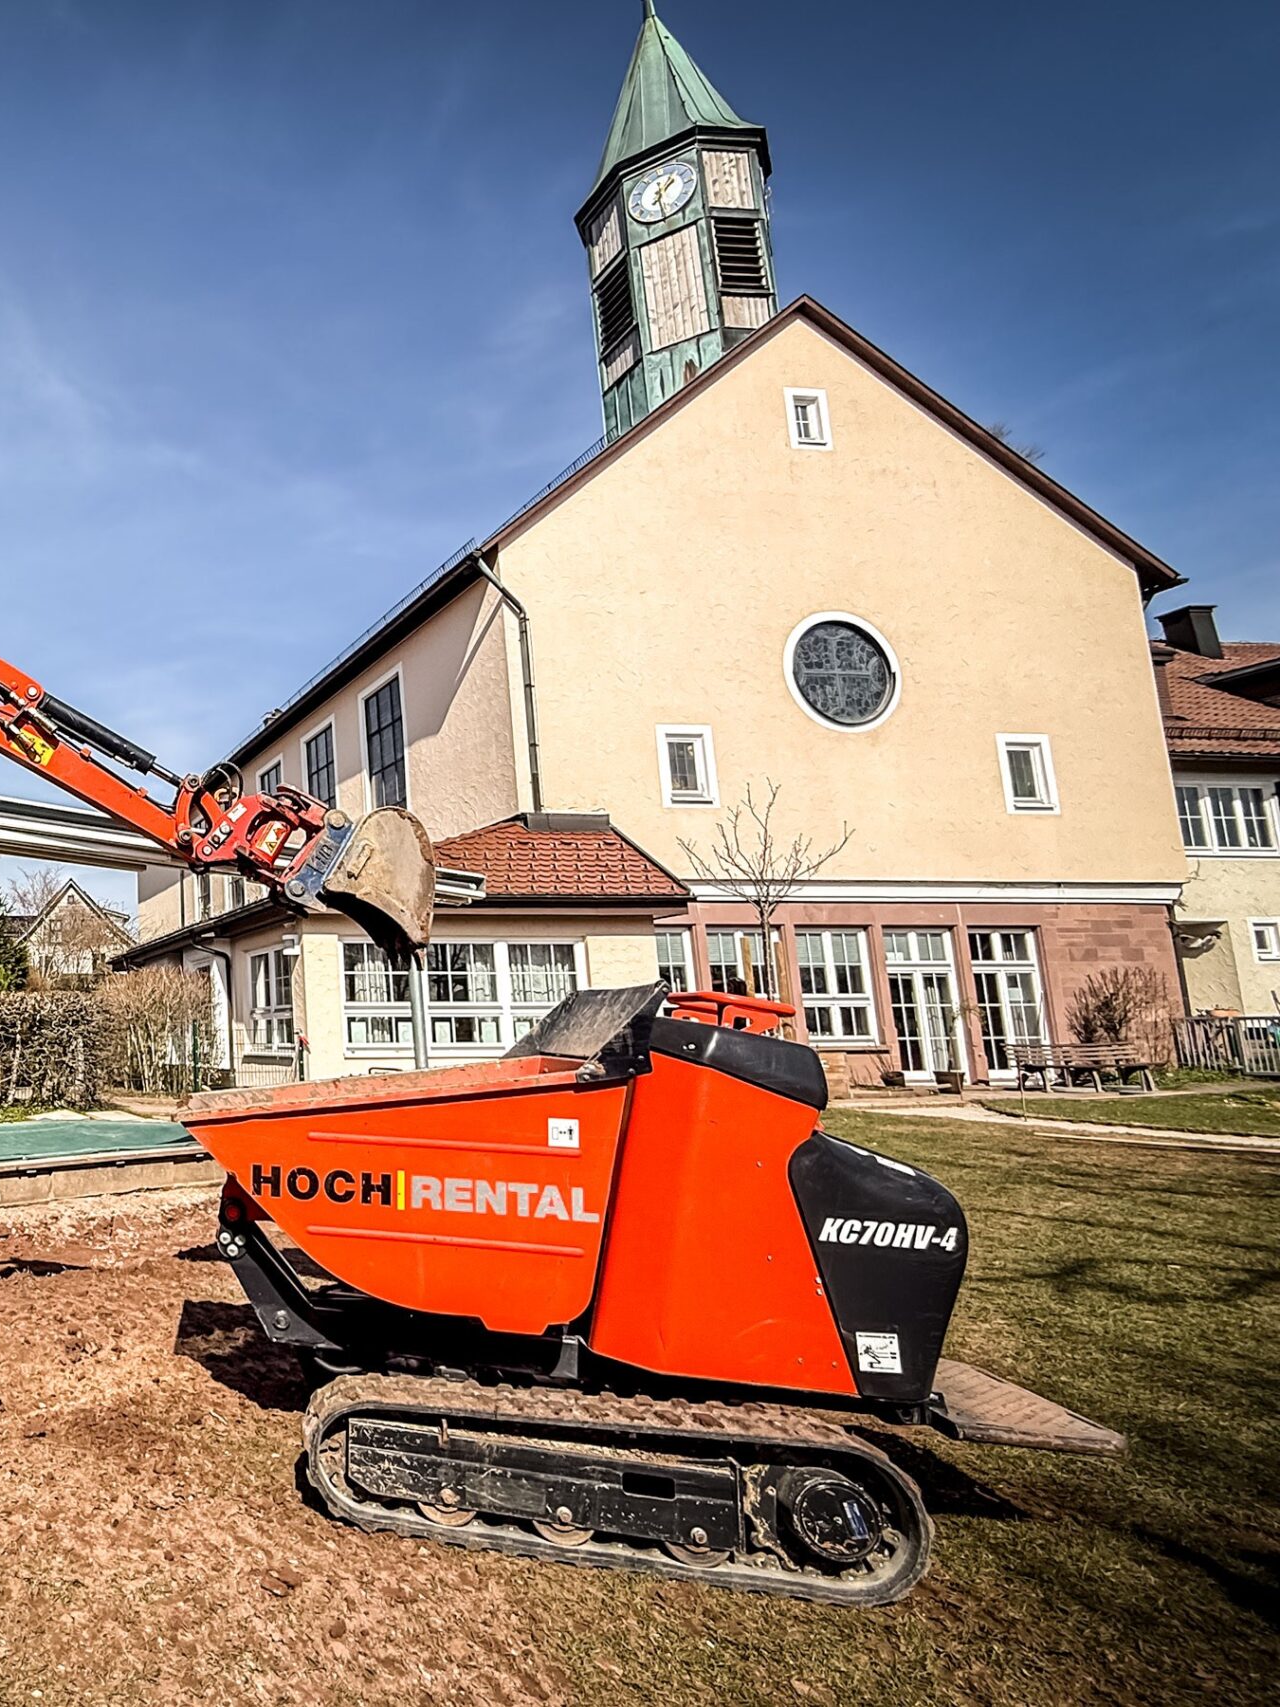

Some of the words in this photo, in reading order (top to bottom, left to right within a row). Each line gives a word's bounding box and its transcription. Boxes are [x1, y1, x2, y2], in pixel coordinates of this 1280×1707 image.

[251, 1163, 392, 1206] HOCH
[411, 1175, 600, 1223] RENTAL
[818, 1217, 959, 1252] KC70HV-4
